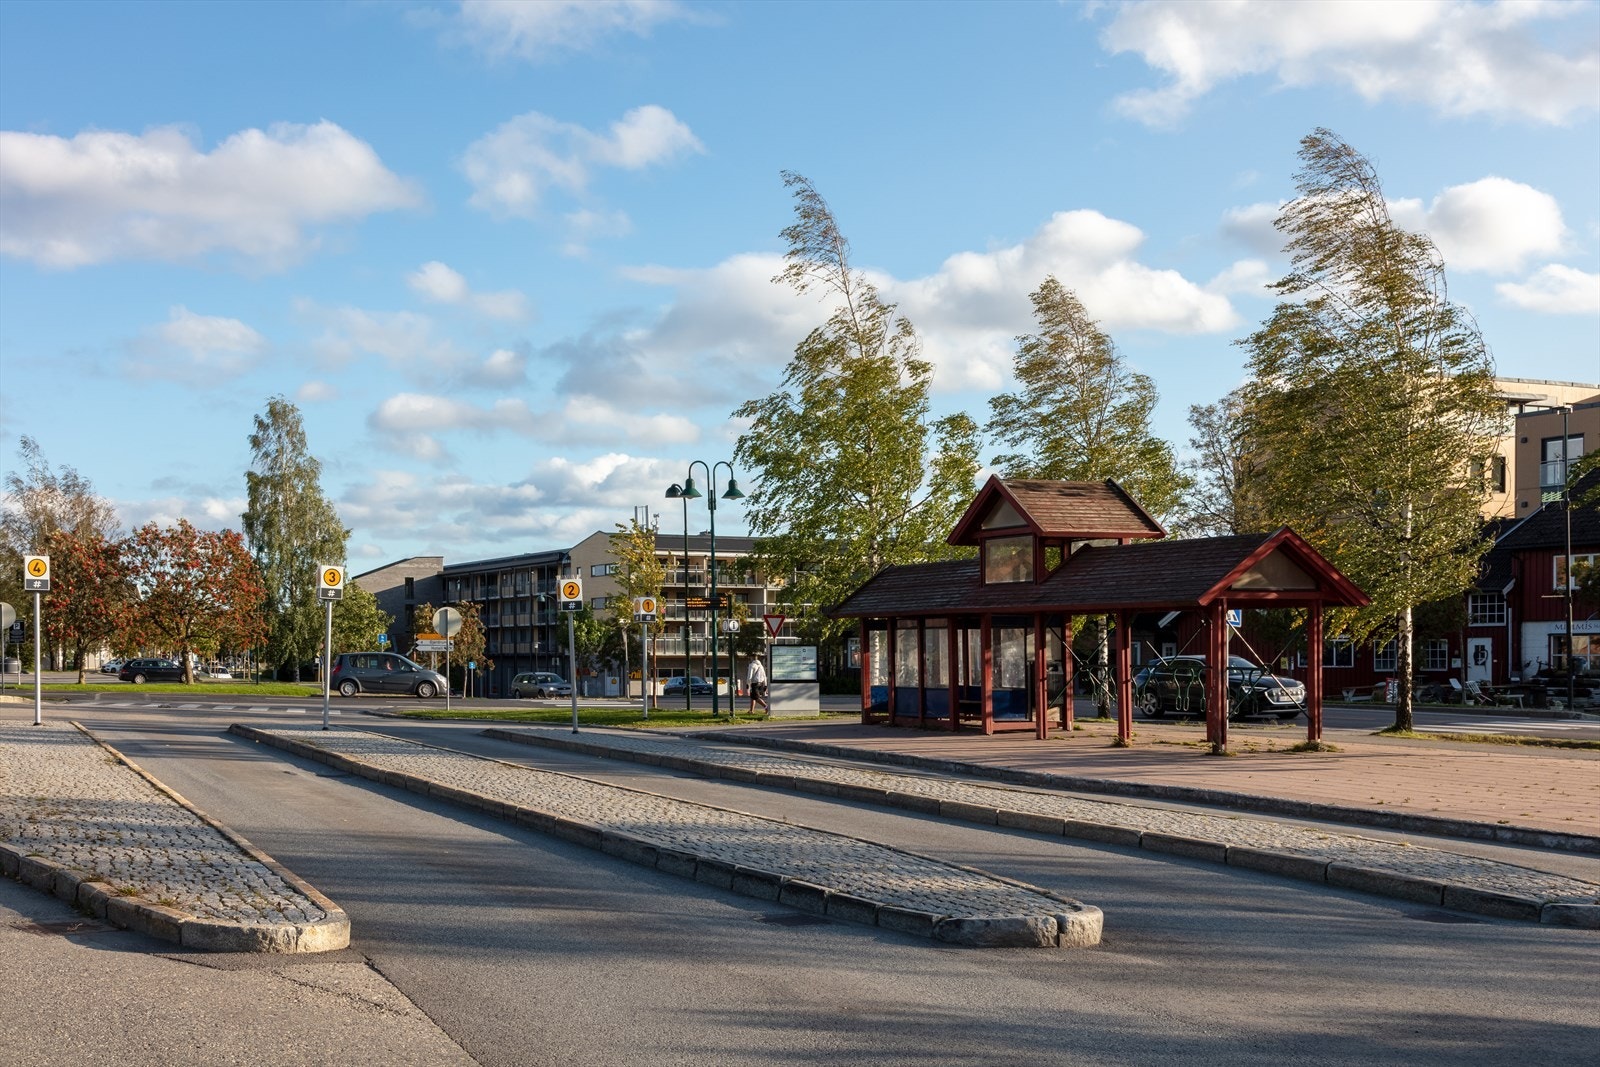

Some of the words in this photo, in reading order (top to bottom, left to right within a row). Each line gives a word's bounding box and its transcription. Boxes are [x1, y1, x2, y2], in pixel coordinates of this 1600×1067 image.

[32, 562, 41, 573] 4
[328, 572, 336, 582] 3
[568, 585, 575, 596] 2
